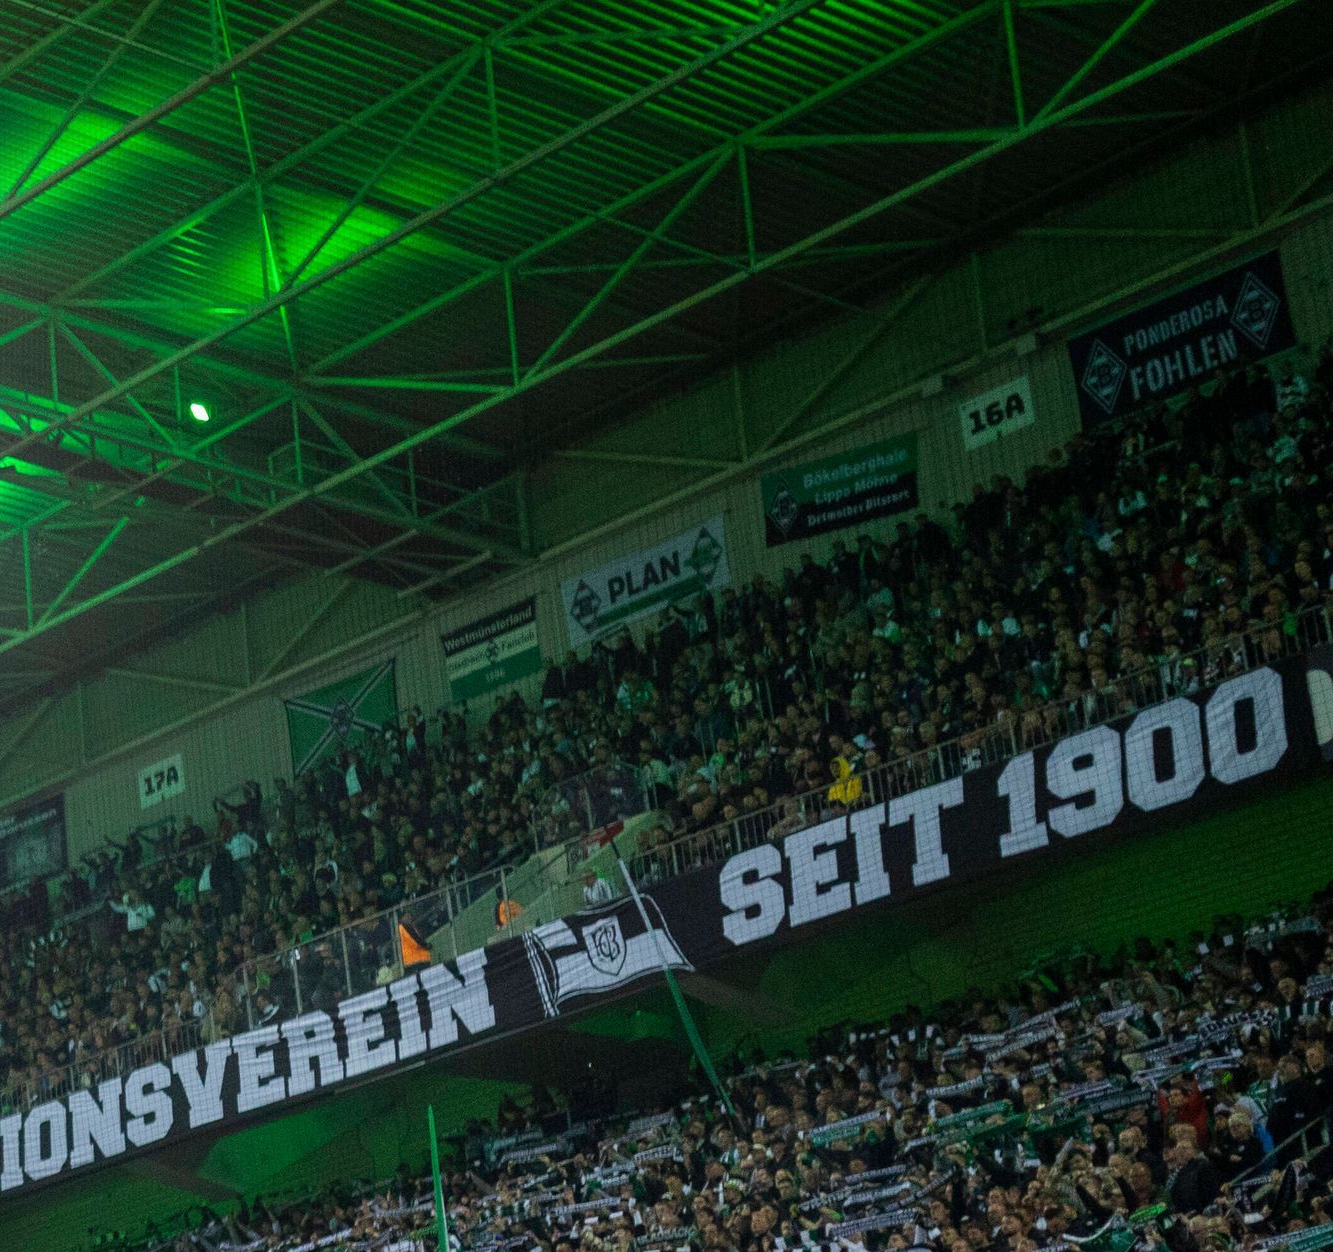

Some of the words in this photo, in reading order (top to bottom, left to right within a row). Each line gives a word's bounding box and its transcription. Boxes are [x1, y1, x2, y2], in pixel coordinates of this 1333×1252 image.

[1124, 294, 1229, 356] PONDEROSA
[1129, 329, 1238, 400] FOHLEN
[968, 394, 1025, 434] 16A
[607, 550, 681, 603] PLAN
[143, 766, 180, 797] 17A
[719, 776, 965, 946] SEIT
[997, 666, 1289, 858] 1900
